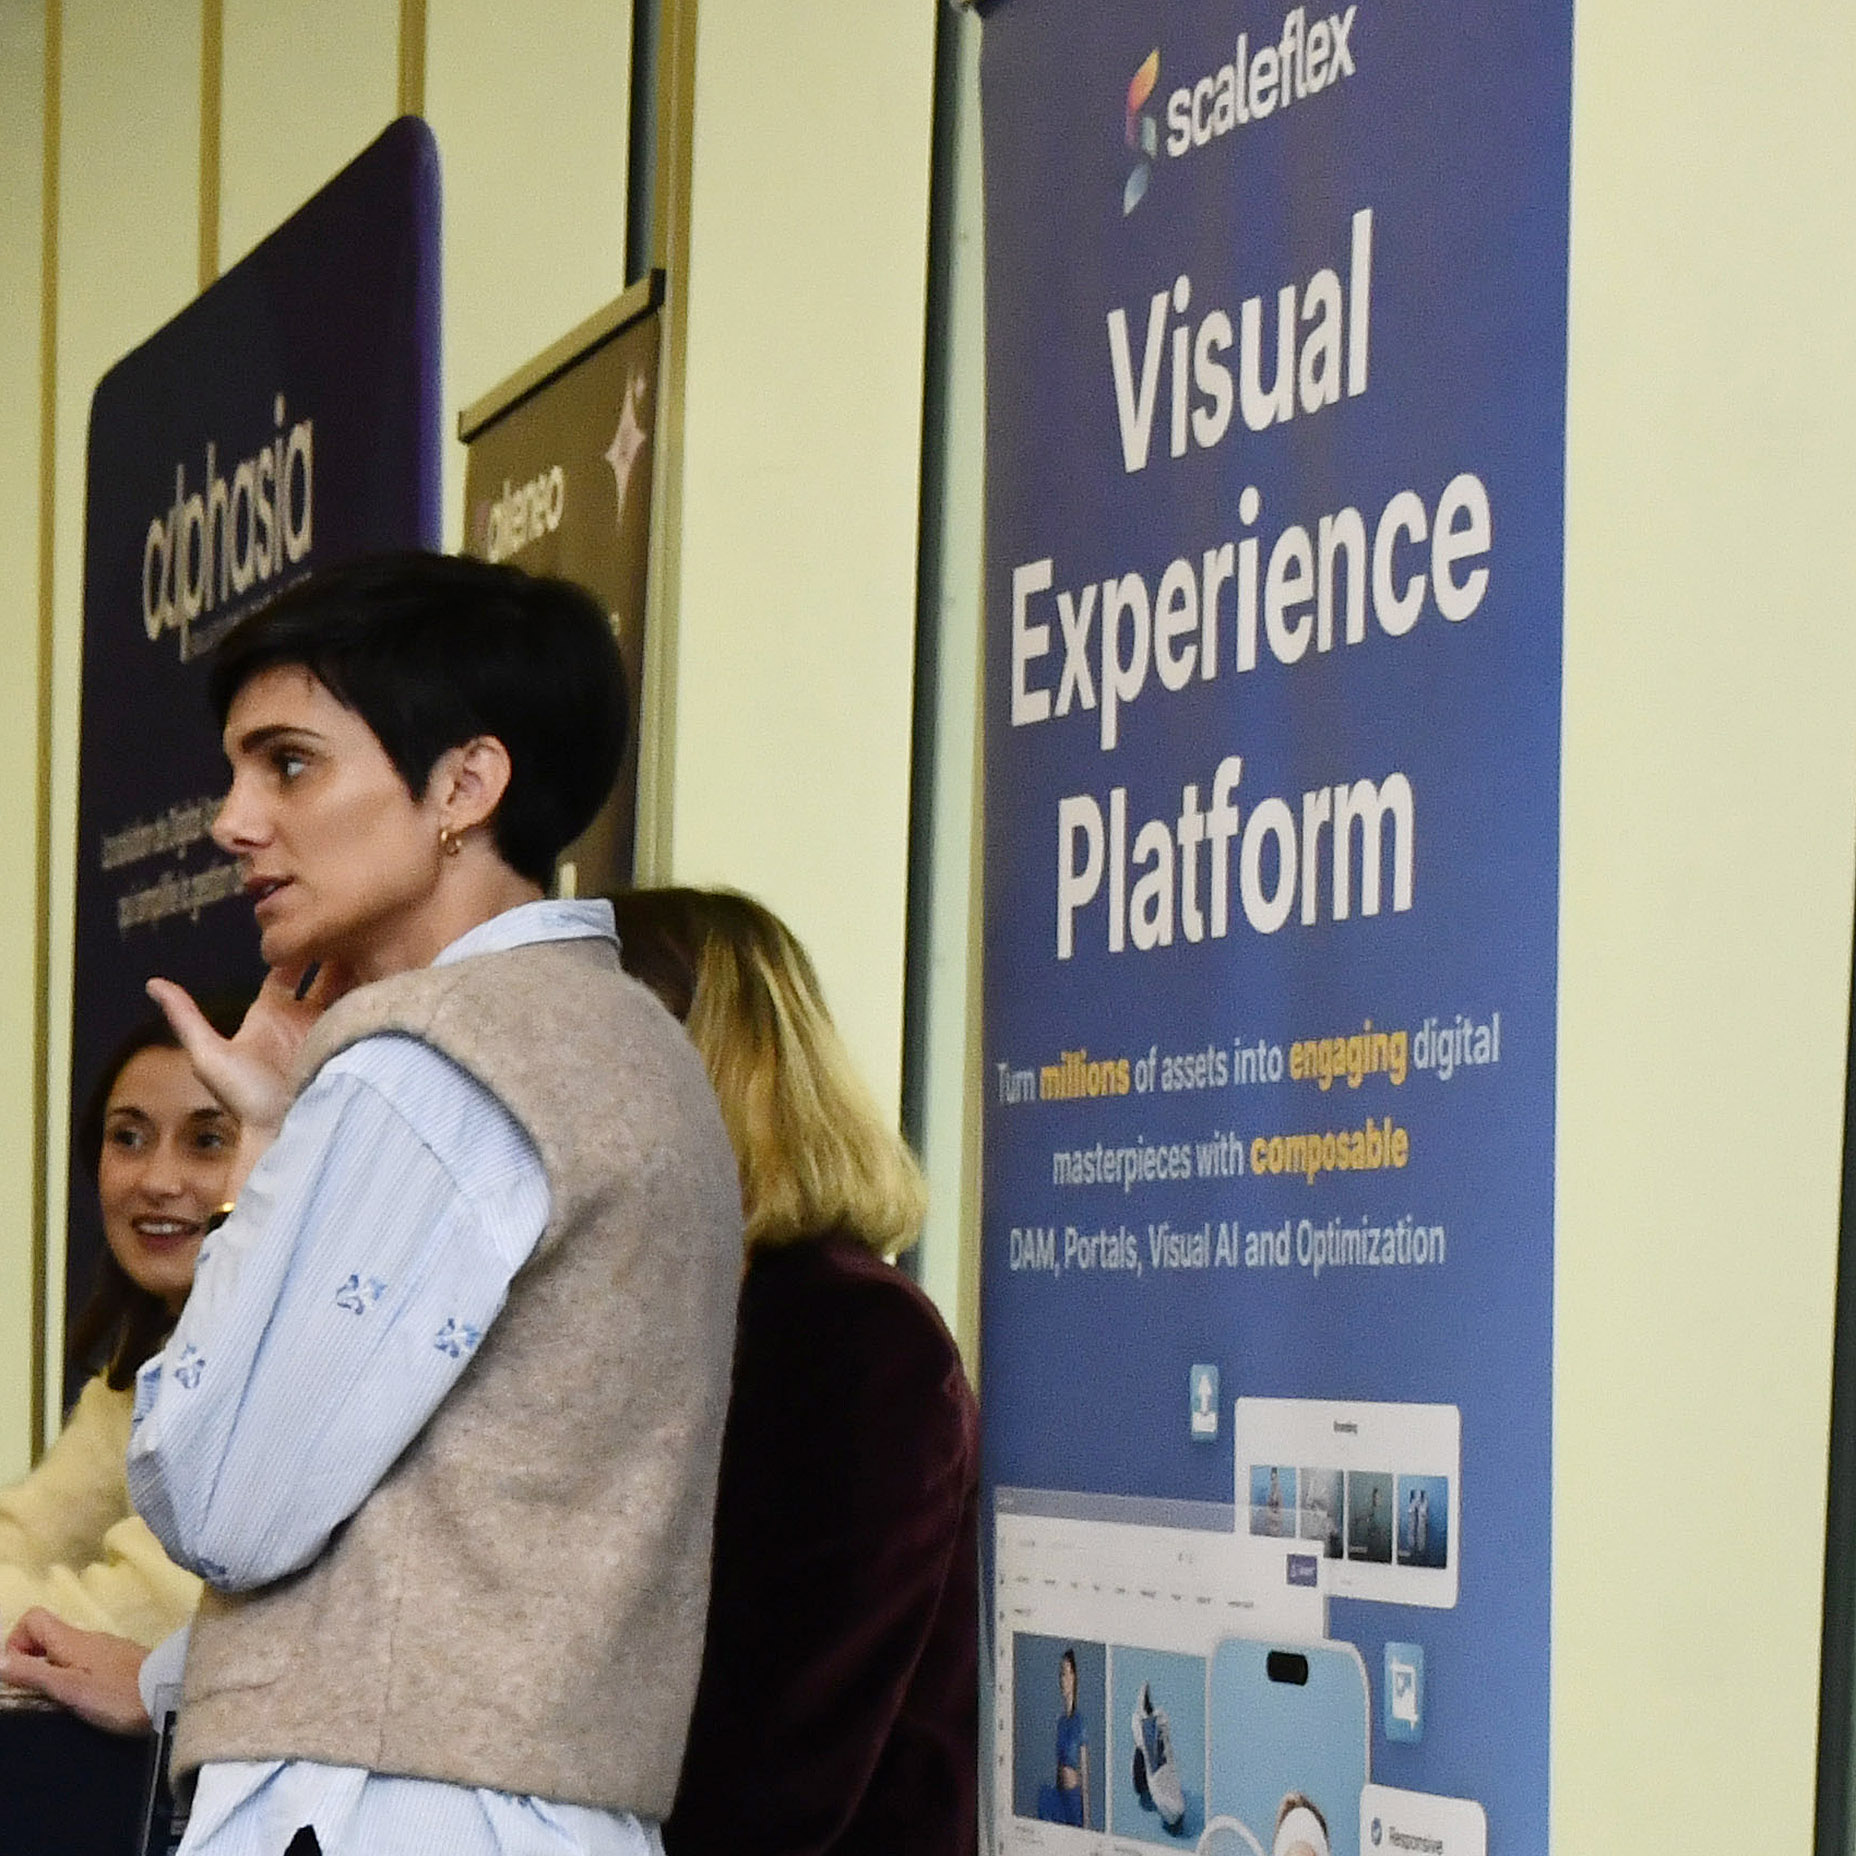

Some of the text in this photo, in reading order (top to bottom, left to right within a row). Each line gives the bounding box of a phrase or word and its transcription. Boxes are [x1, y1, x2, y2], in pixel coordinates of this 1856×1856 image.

[1166, 4, 1358, 158] scaleflex
[1106, 207, 1374, 474] Visual
[1010, 472, 1491, 750] Experience
[1057, 755, 1414, 960] Platform
[997, 1012, 1502, 1103] Turn millions of assets into engaging digital
[1053, 1116, 1410, 1193] masterpieces with composable
[1010, 1213, 1447, 1279] DAM, Portals, Visual AI and Optimization
